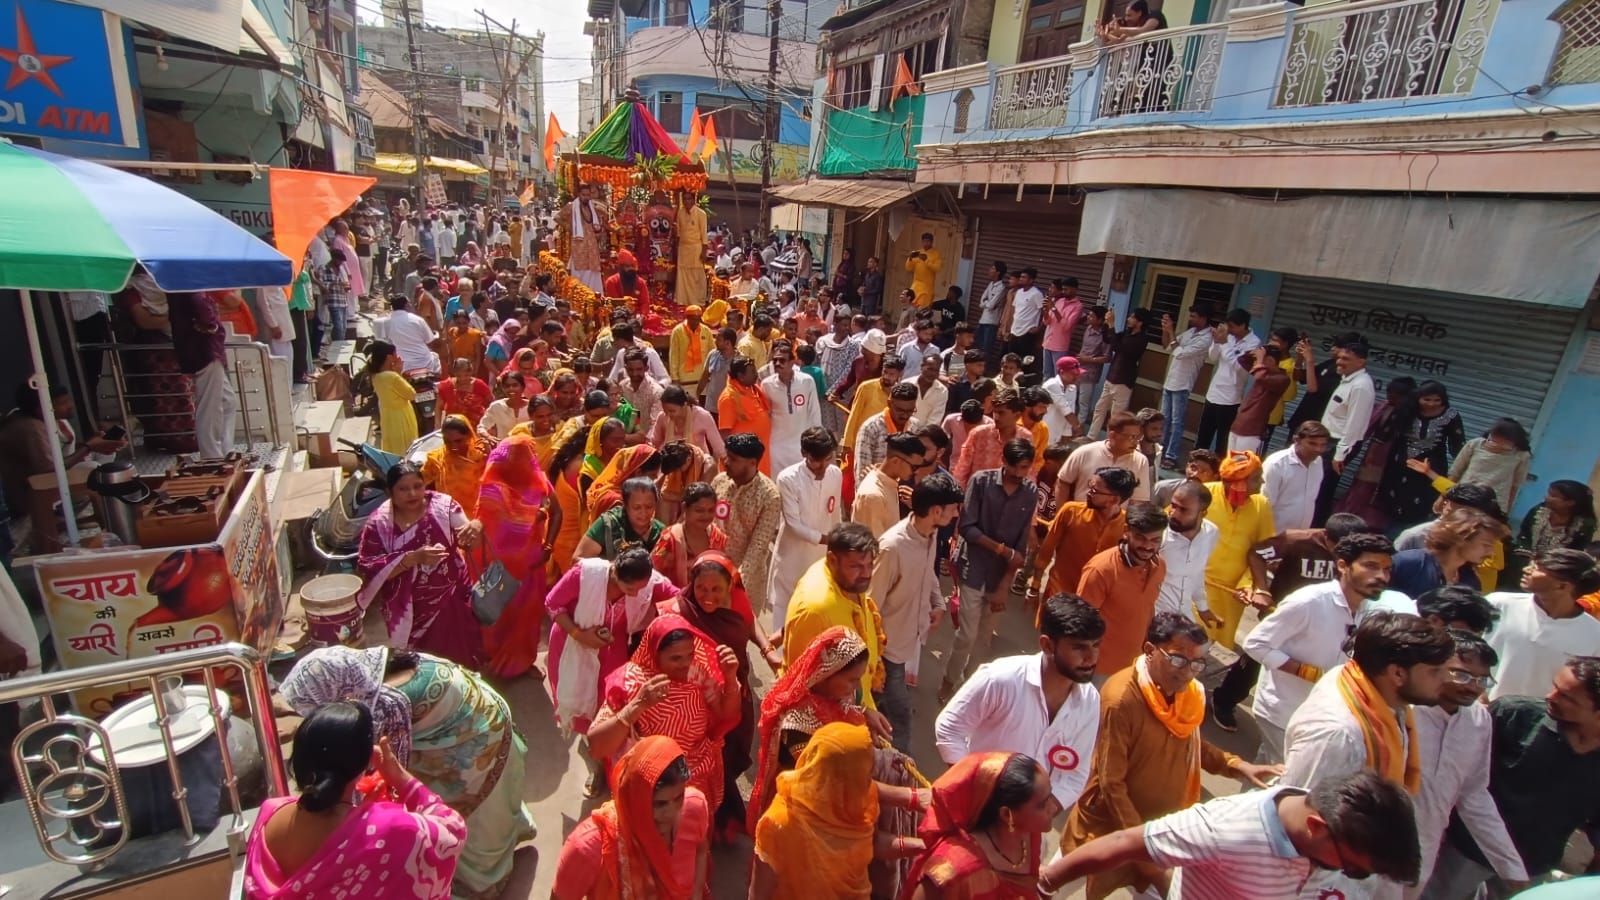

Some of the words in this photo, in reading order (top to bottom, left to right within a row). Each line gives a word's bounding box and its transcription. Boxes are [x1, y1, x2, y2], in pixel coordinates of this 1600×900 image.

[37, 105, 110, 136] ATM
[1309, 303, 1361, 327] सुयश
[1365, 308, 1449, 340] क्लिनिक
[53, 572, 137, 601] चाय
[94, 606, 117, 620] की
[68, 623, 120, 656] यारी
[136, 625, 176, 642] सबसे
